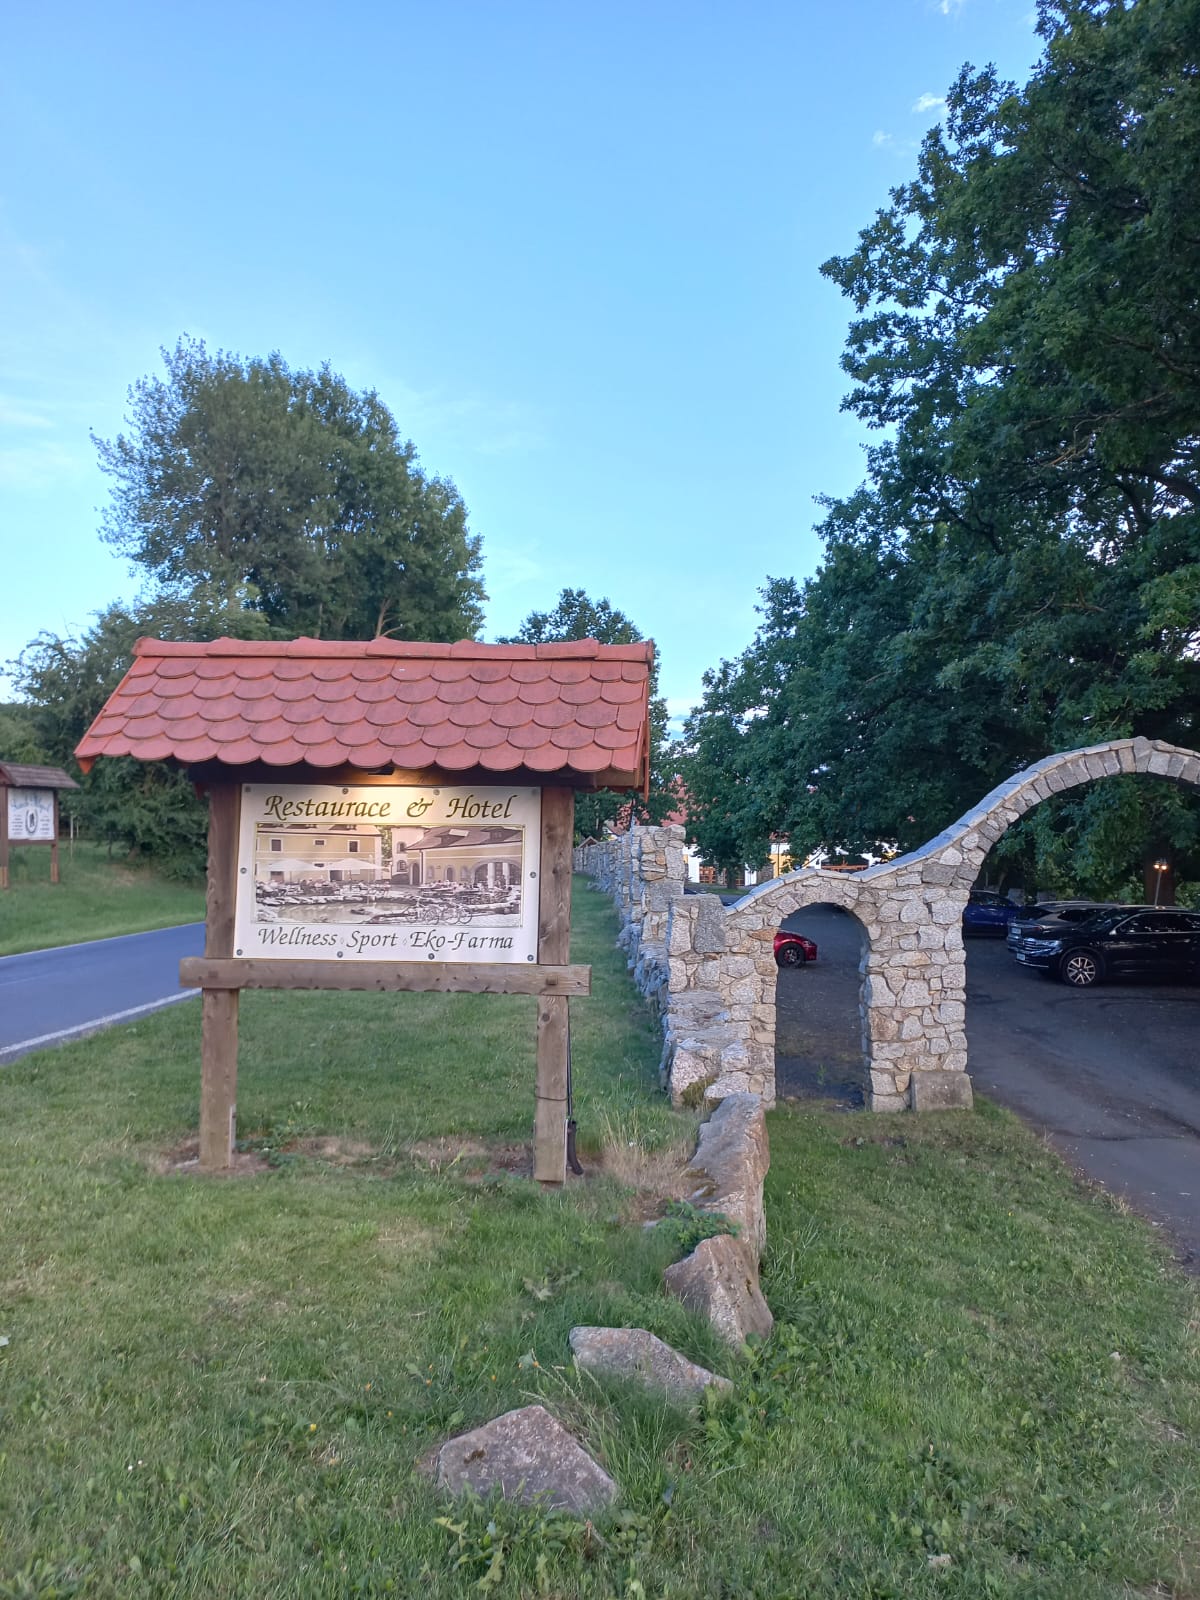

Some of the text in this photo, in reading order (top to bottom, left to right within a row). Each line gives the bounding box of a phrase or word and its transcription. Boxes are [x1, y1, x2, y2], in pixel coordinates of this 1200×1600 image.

[264, 795, 517, 820] Restaurace & Hotel
[257, 927, 514, 954] Wellness Sport Eko-Farma
